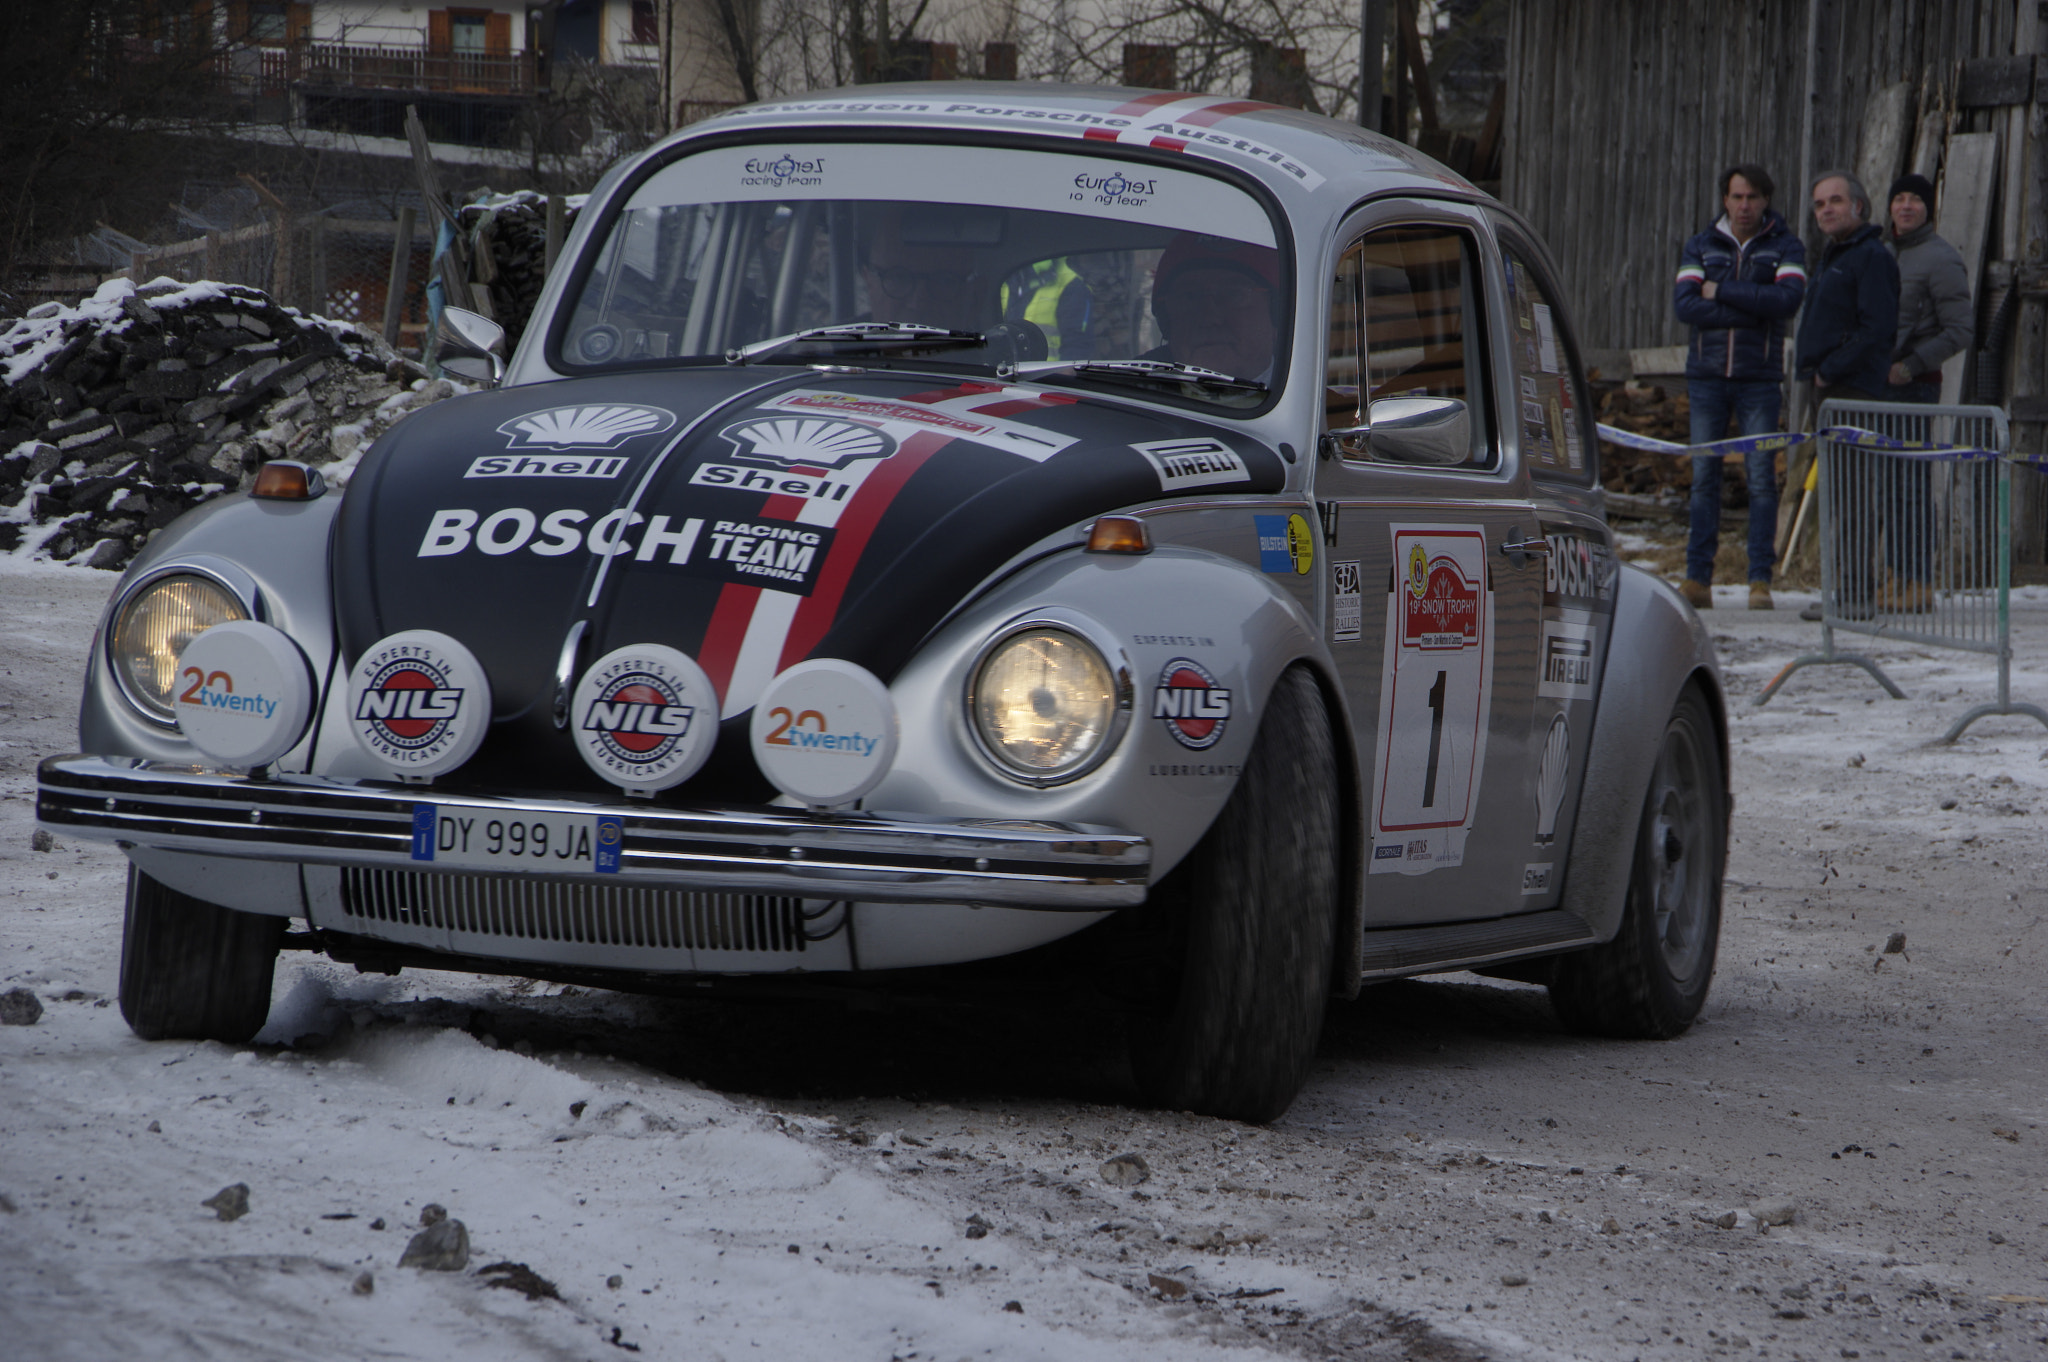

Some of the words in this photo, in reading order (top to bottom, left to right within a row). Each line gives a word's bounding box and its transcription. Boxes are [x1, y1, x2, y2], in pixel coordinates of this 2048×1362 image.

[943, 102, 1132, 127] Porsche
[1142, 121, 1308, 181] Austria
[740, 175, 783, 188] racing
[787, 175, 822, 186] team
[474, 457, 628, 477] Shell
[1146, 443, 1238, 479] PIRELLI
[700, 466, 852, 502] Shell
[416, 507, 705, 566] BOSCH
[713, 520, 822, 546] RACING
[1259, 536, 1289, 551] BILSTEIN
[708, 532, 820, 574] TEAM
[1545, 534, 1595, 599] BOSCH
[734, 562, 807, 584] VIENNA
[1335, 596, 1360, 609] HISTORIC
[1422, 599, 1446, 615] SNOW
[1446, 599, 1476, 614] TROPHY
[1133, 634, 1195, 647] EXPERTS
[1197, 636, 1216, 647] IN
[1335, 616, 1360, 631] RALLIES
[364, 646, 432, 678] EXPERTS
[438, 658, 454, 677] IN
[594, 659, 666, 688] EXPERTS
[669, 675, 686, 693] IN
[1545, 635, 1591, 685] PIRELLI
[201, 686, 279, 720] twenty
[356, 688, 465, 720] NILS
[583, 699, 695, 737] NILS
[1152, 686, 1233, 720] NILS
[364, 727, 456, 762] LUBRICANTS
[789, 726, 881, 757] twenty
[1422, 670, 1447, 808] 1
[589, 737, 684, 777] LUBRICANTS
[1149, 764, 1242, 777] LUBRICANTS
[438, 816, 475, 853] DY
[486, 819, 549, 858] 999
[554, 825, 592, 862] JA
[1523, 869, 1552, 890] Shell
